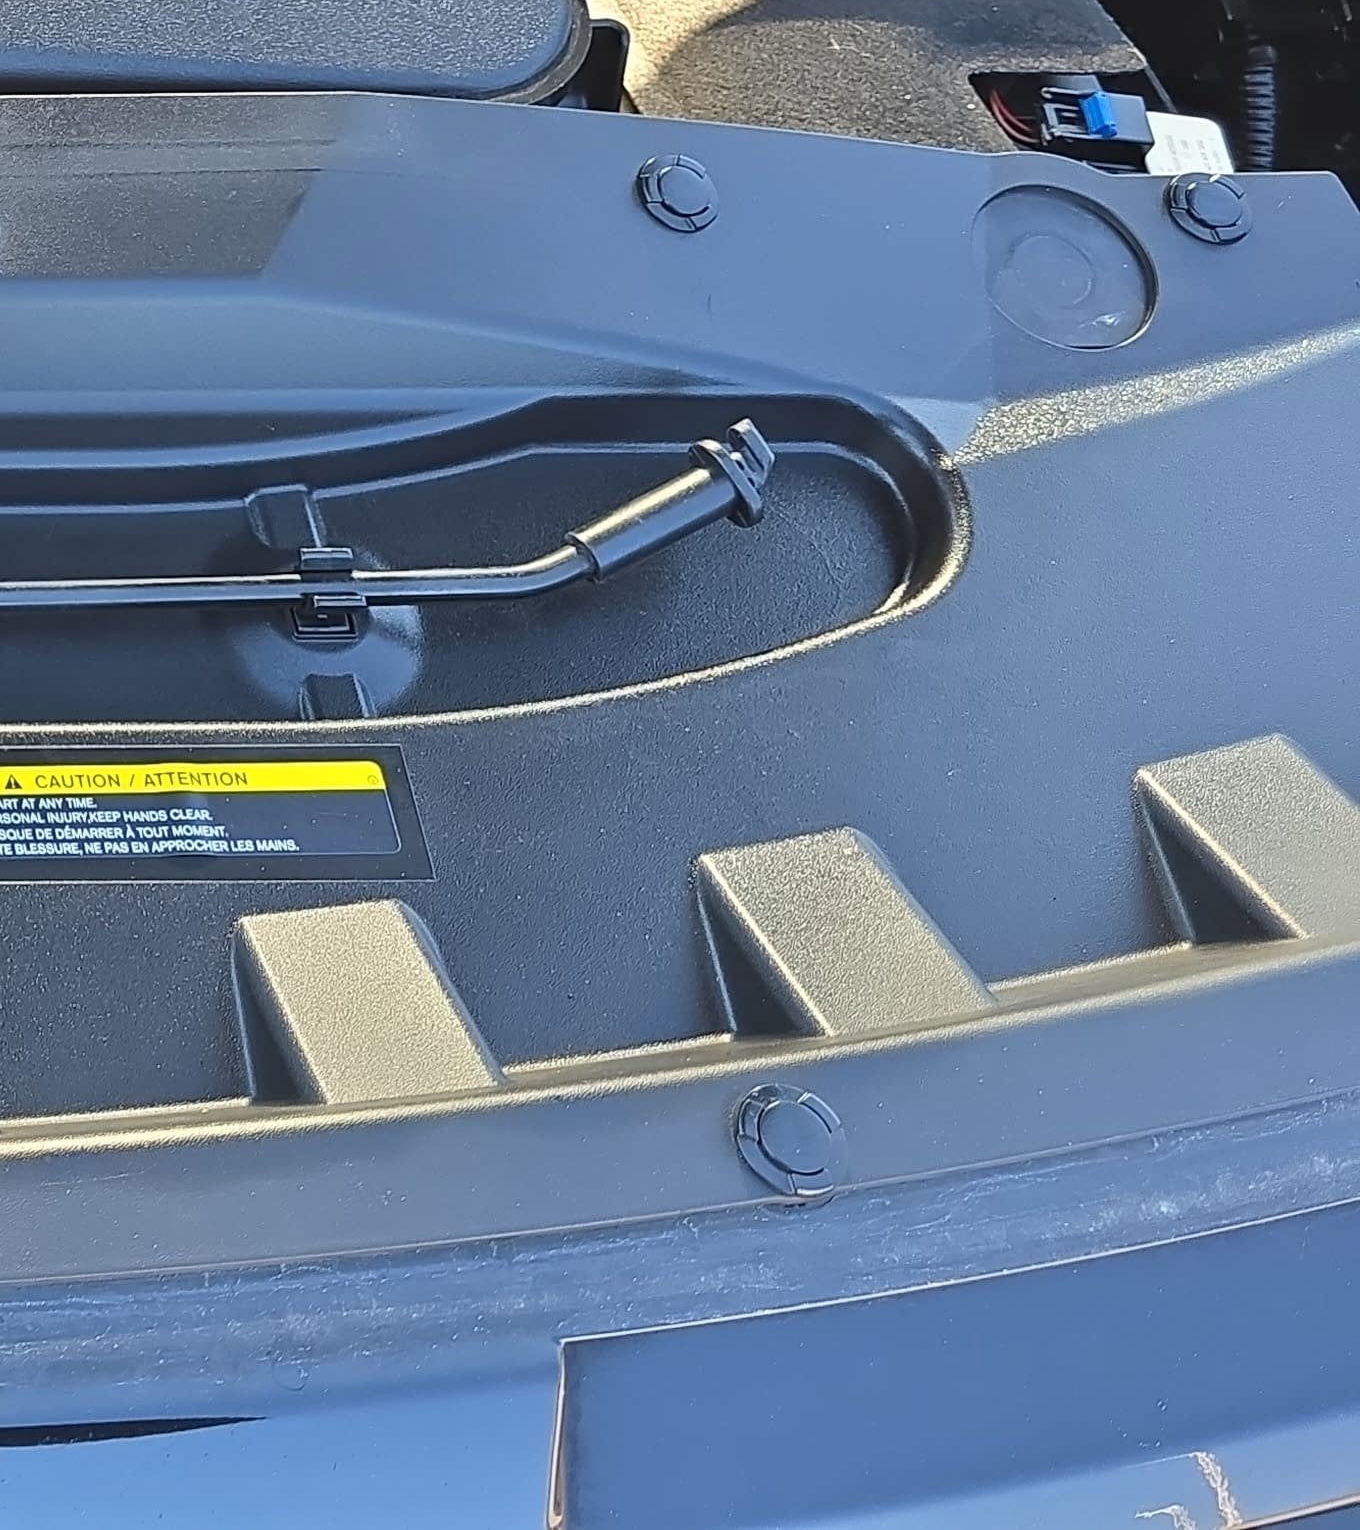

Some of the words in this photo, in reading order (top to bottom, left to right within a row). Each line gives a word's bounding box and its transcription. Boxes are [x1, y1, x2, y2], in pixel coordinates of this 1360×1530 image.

[35, 773, 121, 789] CAUTION
[129, 773, 136, 787] /
[144, 772, 248, 787] ATTENTION
[21, 798, 36, 810] AT
[38, 798, 63, 809] ANY
[65, 797, 97, 808] TIME.
[123, 810, 168, 822] HANDS
[169, 809, 213, 821] CLEAR.
[36, 828, 53, 839] DE
[55, 825, 123, 839] DÉMARRER
[126, 824, 135, 838] À
[137, 826, 169, 838] TOUT
[171, 825, 229, 837] MOMENT.
[15, 843, 84, 856] BLESSURE,
[85, 842, 103, 854] NE
[104, 842, 129, 854] PAS
[133, 841, 149, 853] EN
[152, 840, 229, 853] APPROCHER
[231, 840, 255, 852] LES
[256, 839, 300, 851] MAINS.
